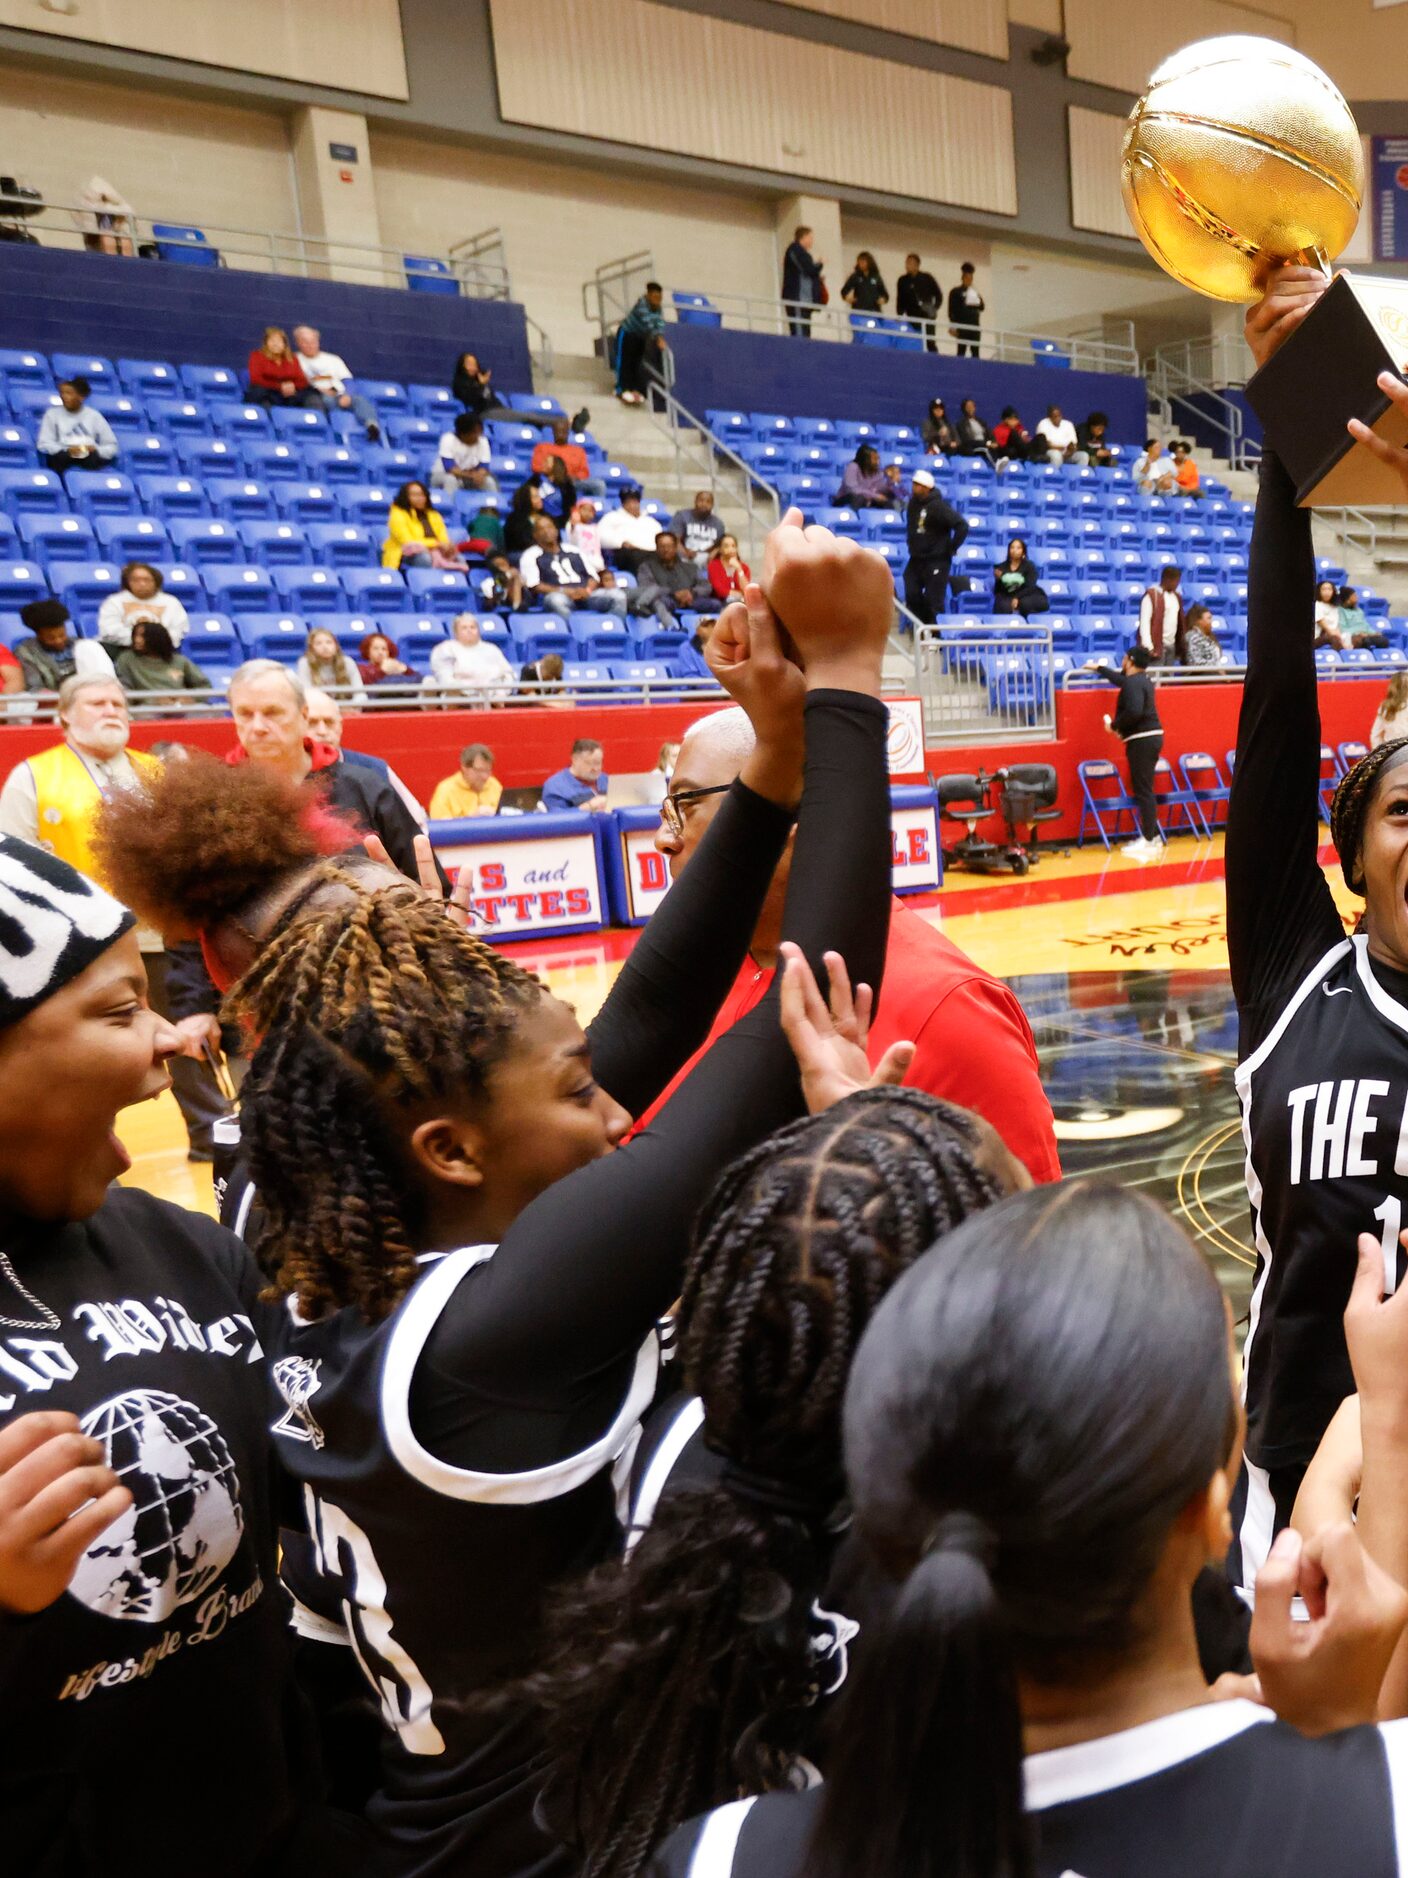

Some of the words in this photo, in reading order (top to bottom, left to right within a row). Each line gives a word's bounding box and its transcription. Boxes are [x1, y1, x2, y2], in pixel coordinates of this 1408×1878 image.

[523, 859, 570, 884] and
[1286, 1079, 1391, 1186] THE
[1373, 1194, 1402, 1296] 1
